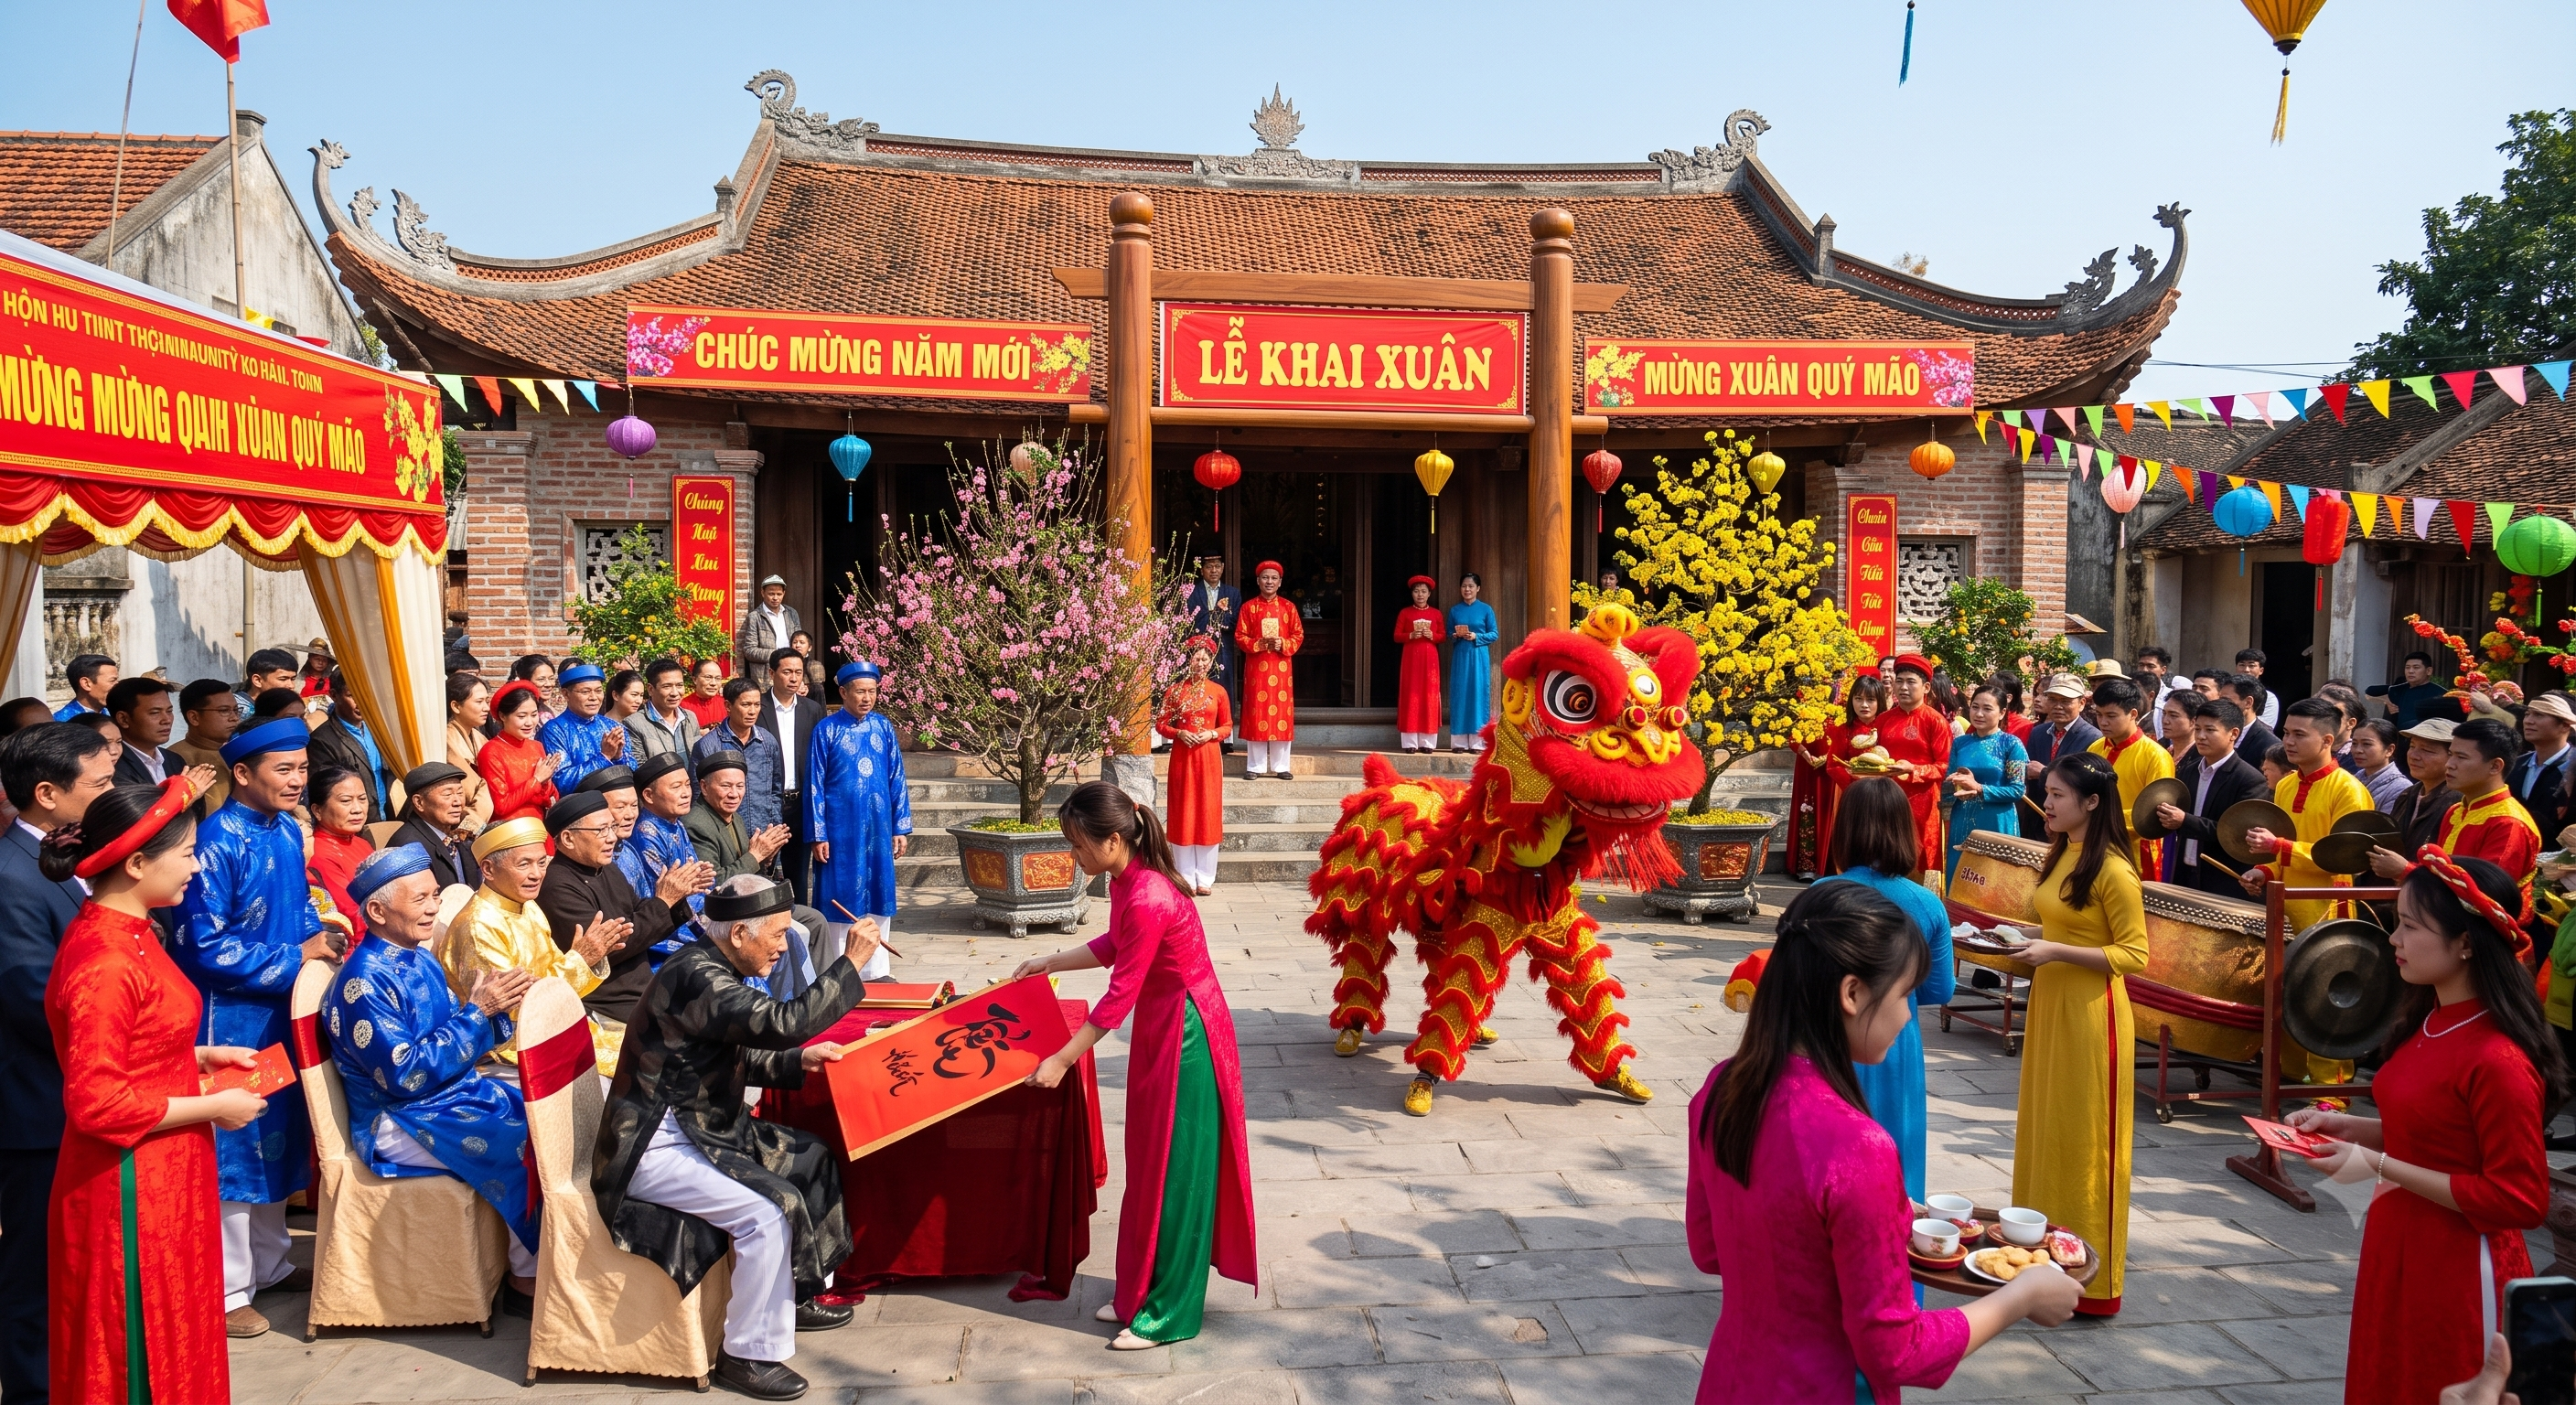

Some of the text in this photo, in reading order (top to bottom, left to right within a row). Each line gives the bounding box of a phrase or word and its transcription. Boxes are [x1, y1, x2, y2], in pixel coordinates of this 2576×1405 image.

[51, 303, 78, 332] HU
[695, 326, 1031, 381] CHÚC MỪNG NĂM MỚI
[1198, 316, 1493, 391] LỄ KHAI XUÂN
[1644, 352, 1921, 399] MỪNG XUÂN QUÝ MÃO
[91, 364, 171, 444] MỪNG
[291, 411, 324, 470] QUÝ
[327, 416, 366, 475] MÃO
